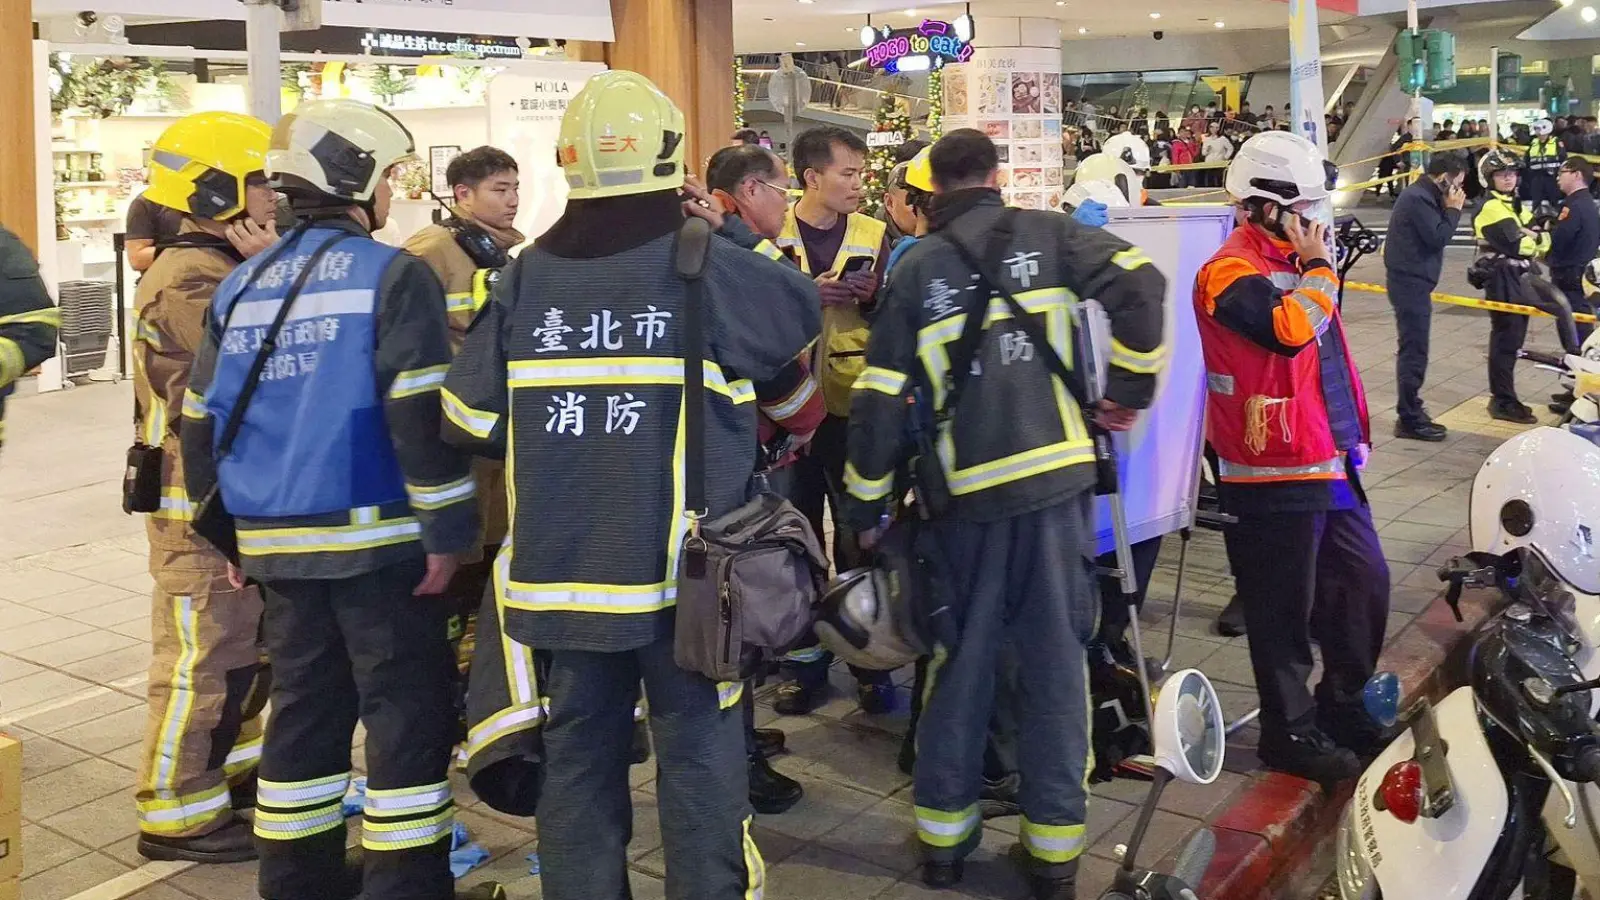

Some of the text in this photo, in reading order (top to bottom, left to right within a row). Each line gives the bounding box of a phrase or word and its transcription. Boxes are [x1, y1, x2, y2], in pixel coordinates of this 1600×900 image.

[866, 37, 909, 66] TOGO
[910, 34, 929, 53] to
[534, 81, 569, 93] HOLA
[598, 135, 638, 152] 三大
[868, 132, 902, 146] HOLA
[923, 251, 1043, 322] 臺市
[532, 305, 673, 353] 臺北市
[545, 391, 646, 436] 消防
